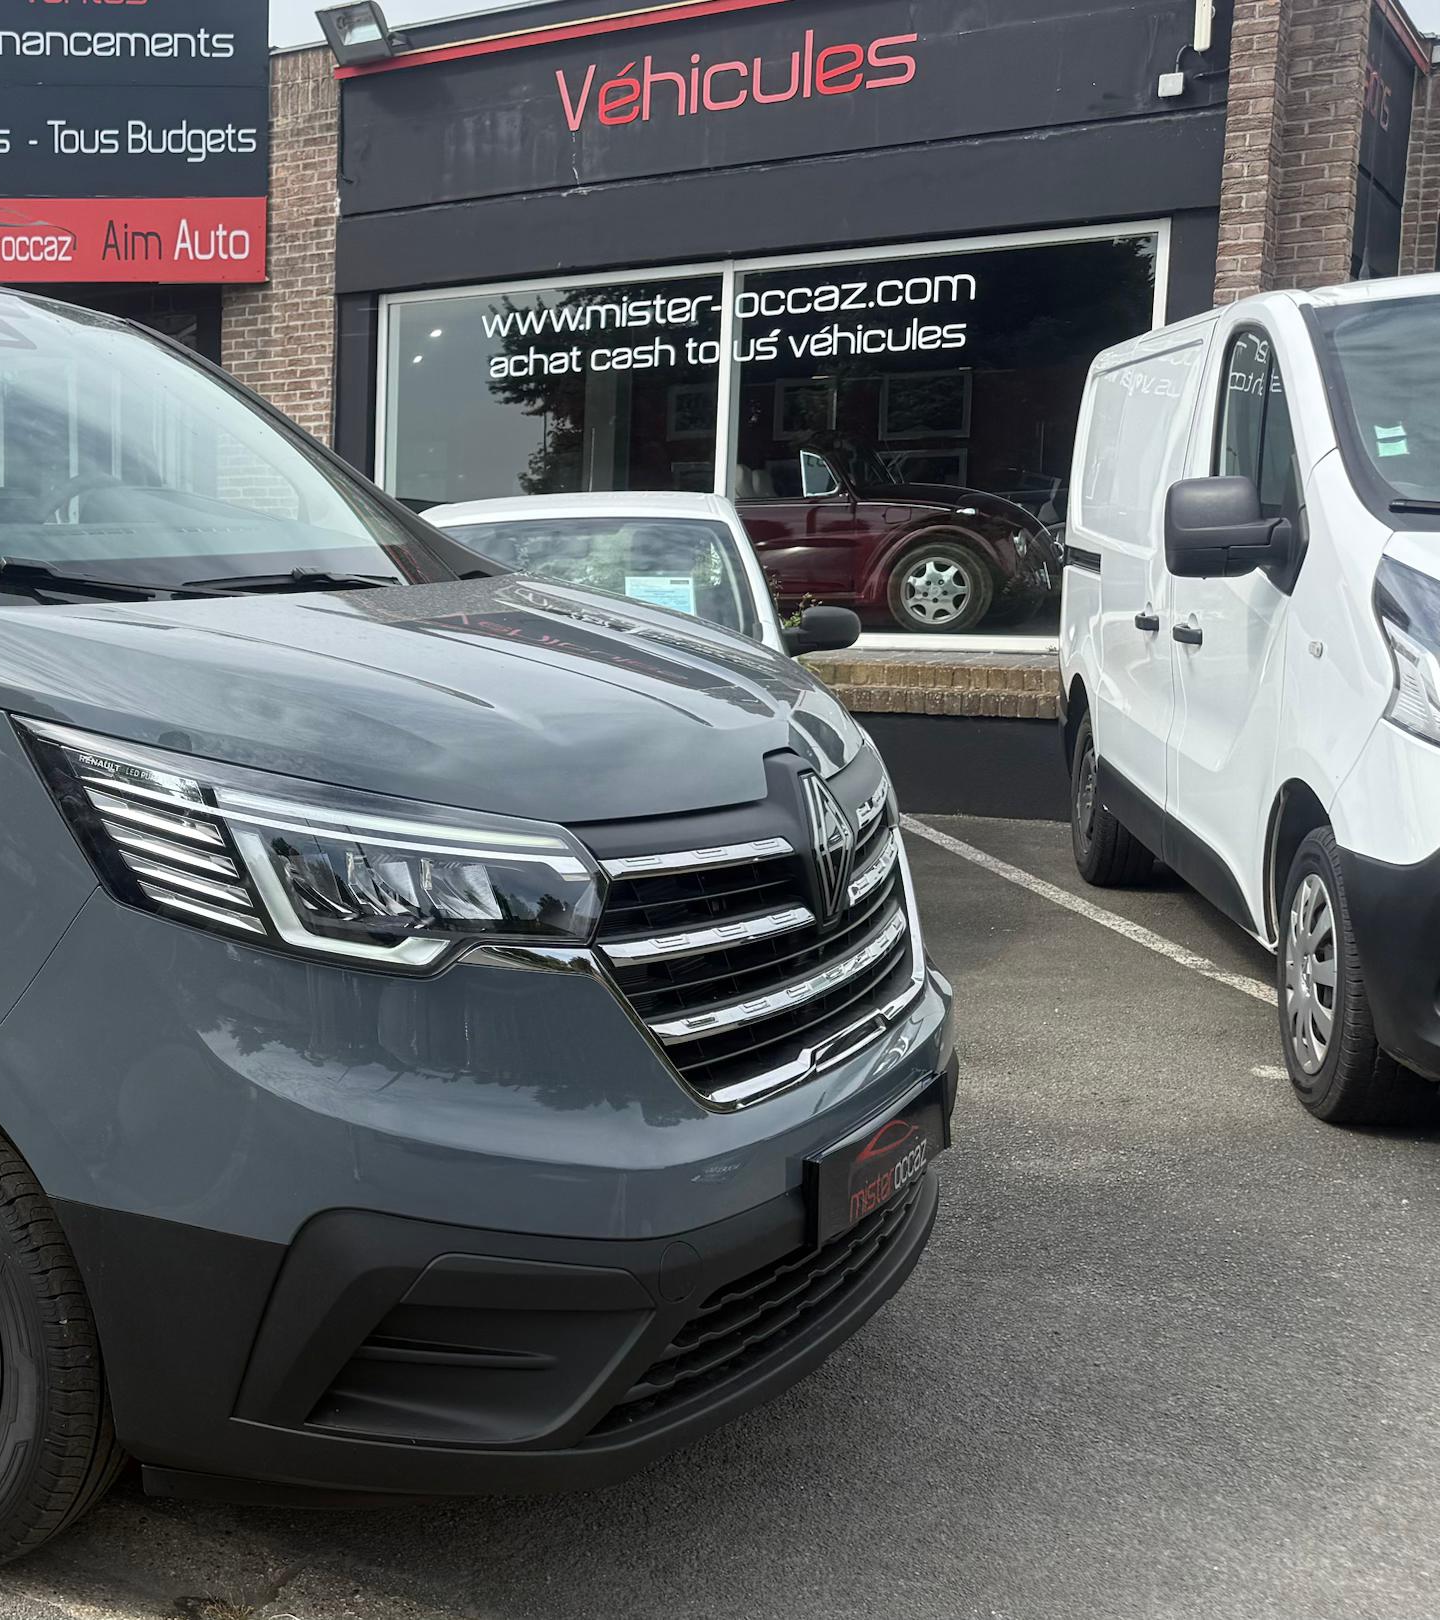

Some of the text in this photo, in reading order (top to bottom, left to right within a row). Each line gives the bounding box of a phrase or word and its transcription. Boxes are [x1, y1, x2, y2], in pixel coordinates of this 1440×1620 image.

[555, 29, 919, 132] Véhicules
[47, 119, 120, 155] Tous
[127, 119, 258, 163] Budgets
[101, 219, 163, 262] Aim
[173, 218, 250, 261] Auto
[489, 345, 583, 379] achat
[590, 336, 676, 372] cash
[788, 317, 968, 359] véhicules
[78, 753, 121, 772] RENAULT
[125, 766, 140, 777] LED
